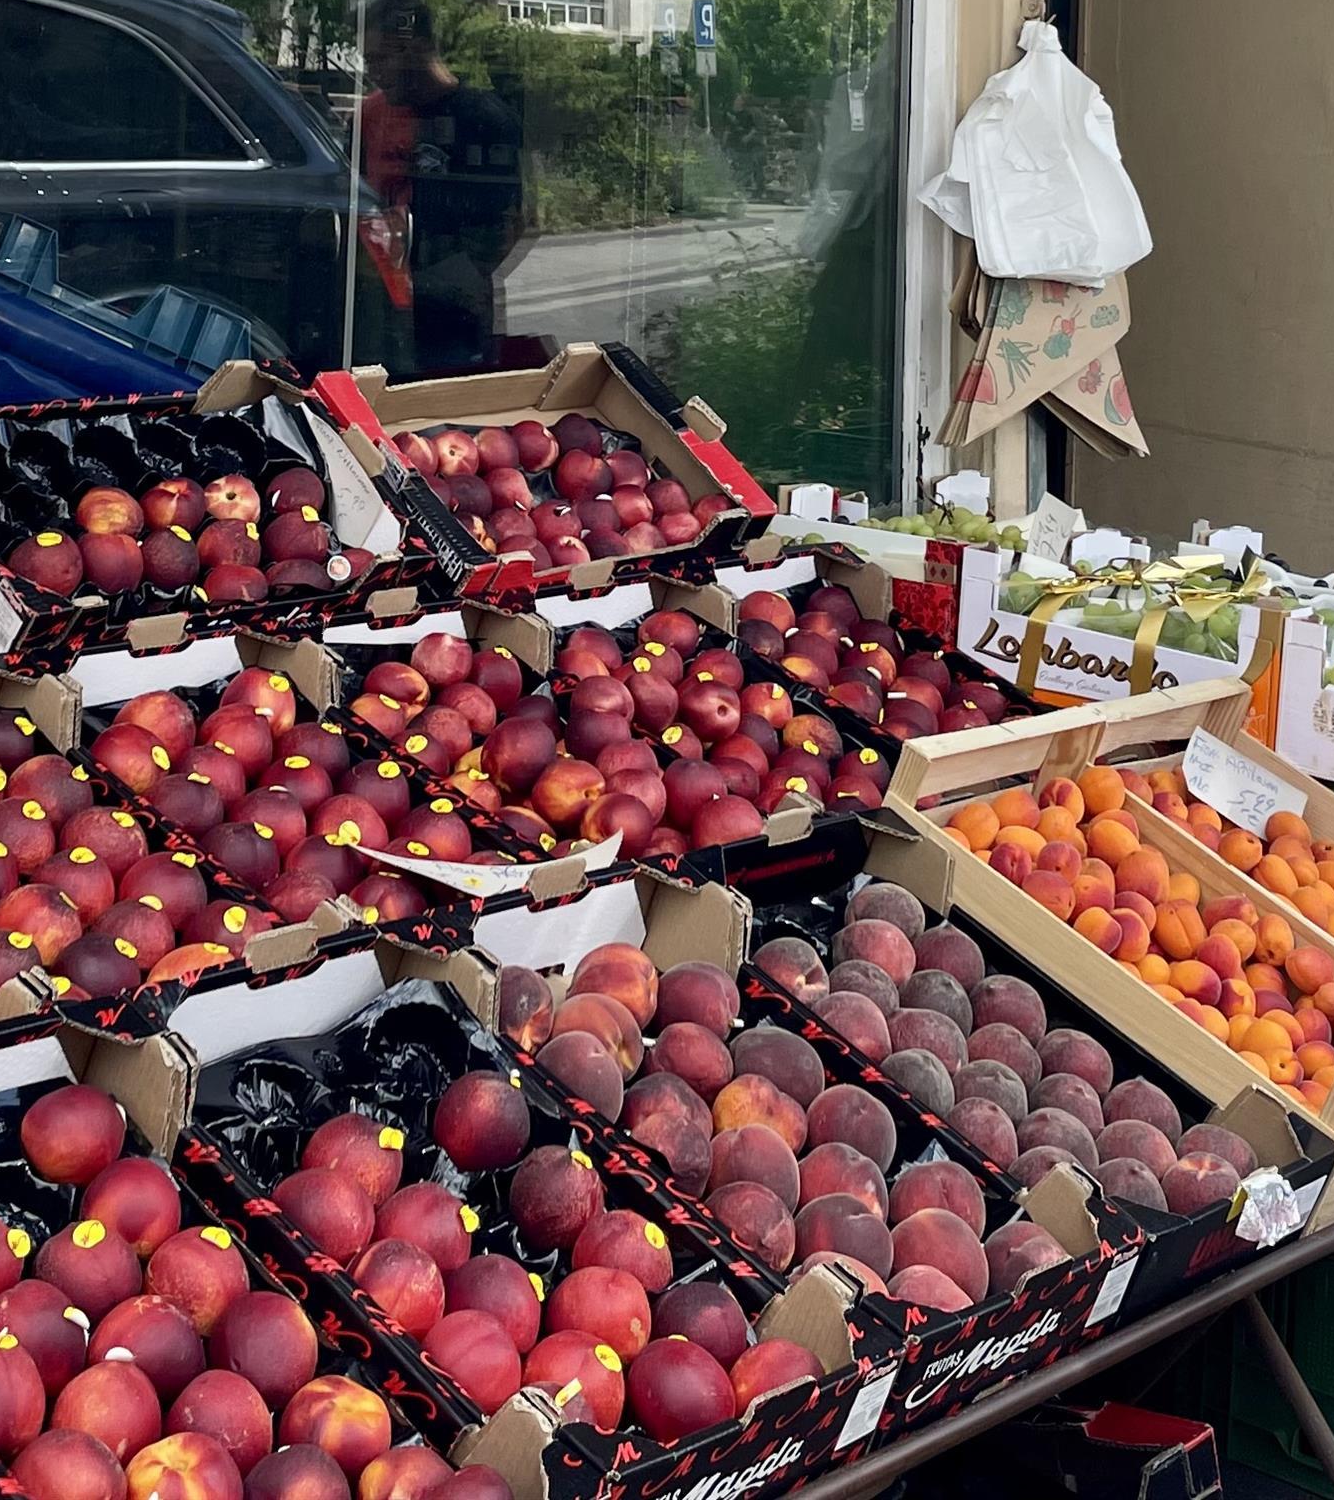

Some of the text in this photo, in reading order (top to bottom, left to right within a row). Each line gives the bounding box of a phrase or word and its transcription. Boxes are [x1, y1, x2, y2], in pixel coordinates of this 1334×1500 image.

[904, 1307, 1062, 1410] Magda
[922, 1349, 964, 1382] FRUTAS
[680, 1436, 805, 1500] Magda
